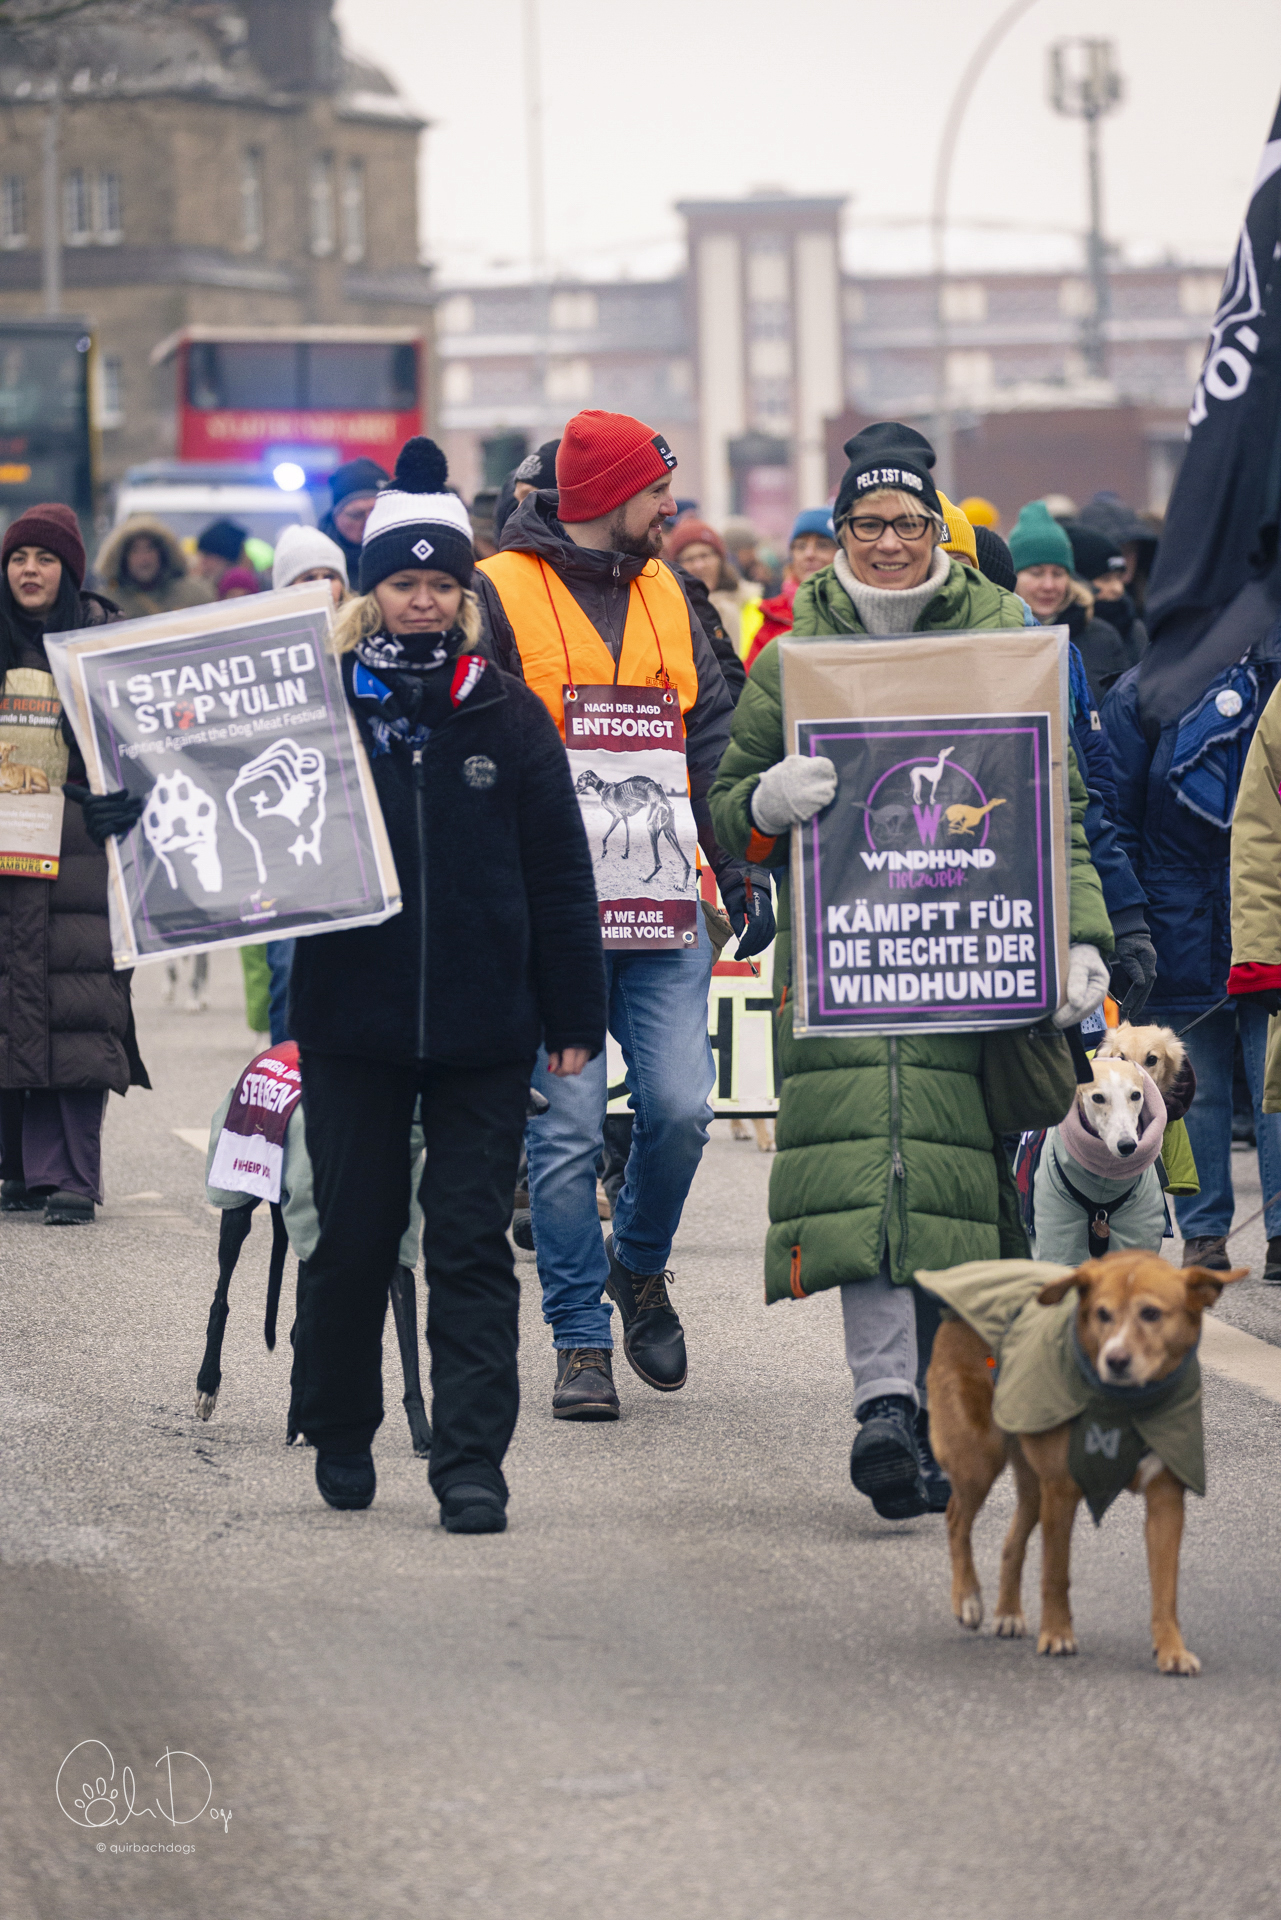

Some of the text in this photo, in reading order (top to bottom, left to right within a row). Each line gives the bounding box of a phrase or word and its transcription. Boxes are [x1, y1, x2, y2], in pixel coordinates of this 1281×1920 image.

[857, 469, 924, 491] PELZ IST MORD
[107, 642, 316, 708] I STAND TO
[13, 699, 60, 714] RECHTE
[219, 677, 309, 719] YULIN
[584, 703, 661, 715] NACH DER JAGD
[19, 713, 27, 724] in
[572, 717, 674, 738] ENTSORGT
[118, 705, 328, 759] Fighting Against the Dog Meat Festival
[0, 861, 41, 872] AMBURG
[859, 848, 997, 871] WINDHUND
[613, 910, 636, 923] WE
[637, 910, 664, 923] ARE
[827, 894, 1034, 934] KÄMPFT FÜR
[601, 925, 675, 939] HEIR VOICE
[828, 934, 1036, 968] DIE RECHTE DER
[830, 969, 1036, 1004] WINDHUNDE
